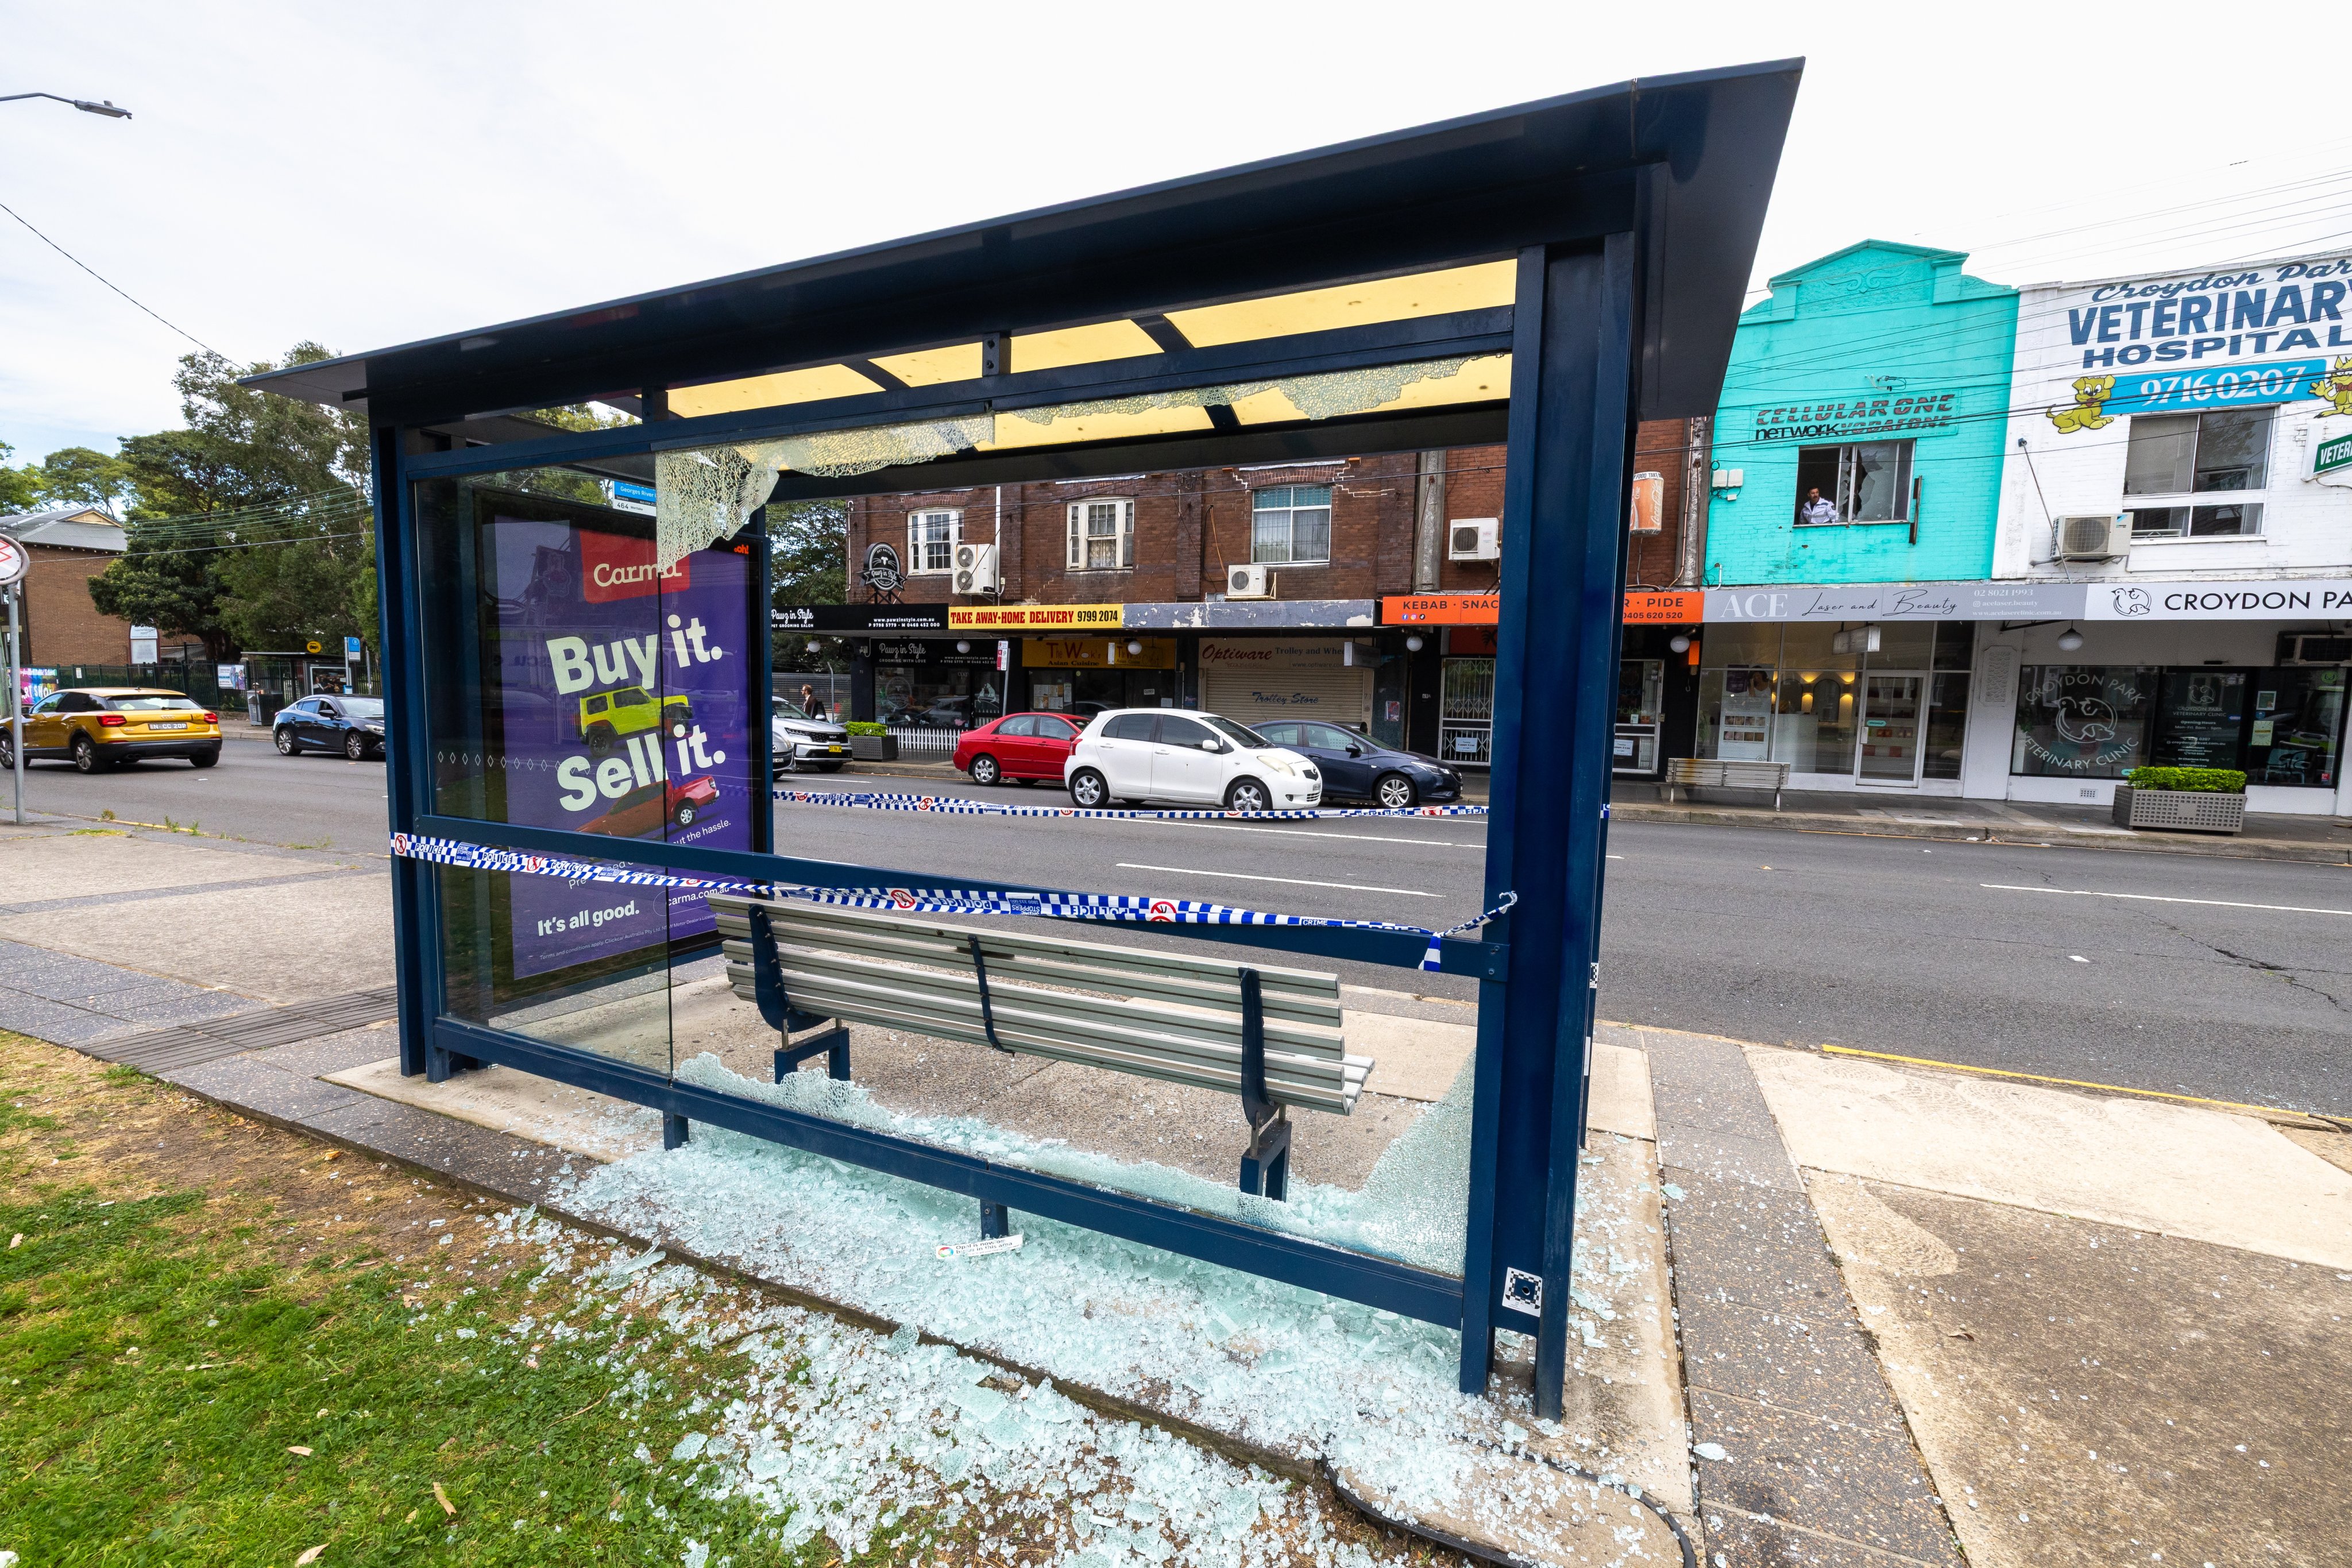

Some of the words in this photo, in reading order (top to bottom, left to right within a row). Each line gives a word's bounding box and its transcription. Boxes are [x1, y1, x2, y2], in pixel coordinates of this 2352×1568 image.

[2092, 272, 2264, 302] Croydon
[2274, 258, 2352, 284] Par
[2082, 326, 2352, 369] HOSPITAL
[2140, 374, 2212, 406] 9716
[2216, 366, 2307, 400] 0207
[1757, 400, 1888, 425] CELLULAR
[1894, 394, 1956, 415] ONE
[620, 486, 640, 496] Georges
[641, 489, 654, 498] River
[617, 502, 629, 510] 464
[1987, 589, 2009, 597] 8021
[2164, 591, 2318, 611] CROYDON
[2323, 590, 2352, 609] PA
[1403, 600, 1447, 609] KEBAB
[1462, 600, 1499, 609] SNAC
[1647, 598, 1683, 607] PIDE
[1720, 593, 1788, 618] ACE
[1802, 592, 1844, 617] Laser
[1851, 598, 1878, 610] and
[1883, 589, 1957, 617] Beauty
[1982, 599, 2038, 607] acelaser.beauty
[771, 609, 789, 624] Pawz
[790, 609, 797, 619] in
[797, 608, 814, 624] Style
[951, 612, 972, 624] TAKE
[1030, 611, 1074, 623] DELIVERY
[1077, 611, 1096, 622] 9799
[1099, 610, 1118, 622] 2074
[546, 634, 658, 695] Buy
[667, 614, 723, 668] it.
[879, 643, 899, 659] Pawz
[900, 644, 907, 654] in
[908, 643, 926, 659] Style
[1202, 644, 1273, 663] Optiware
[1275, 647, 1303, 656] Trolley
[1306, 647, 1320, 655] and
[2026, 674, 2105, 705] CROYDON
[2108, 679, 2146, 705] PARK
[1252, 692, 1287, 705] Trolley
[1291, 693, 1319, 704] Store
[2025, 731, 2091, 770] VETERINARY
[2096, 737, 2139, 766] CLINIC
[557, 733, 669, 812] Sell
[674, 724, 726, 776] it.
[686, 829, 701, 841] the
[703, 820, 732, 837] hassle.
[415, 843, 443, 854] POLICE
[482, 853, 513, 864] POLICE
[551, 861, 588, 872] POLICE
[940, 898, 992, 909] POLICE
[569, 909, 589, 929] all
[592, 899, 640, 927] good.
[565, 944, 590, 954] conditions
[591, 940, 604, 948] apply.
[605, 936, 624, 944] Clickcar
[624, 930, 644, 940] Australia
